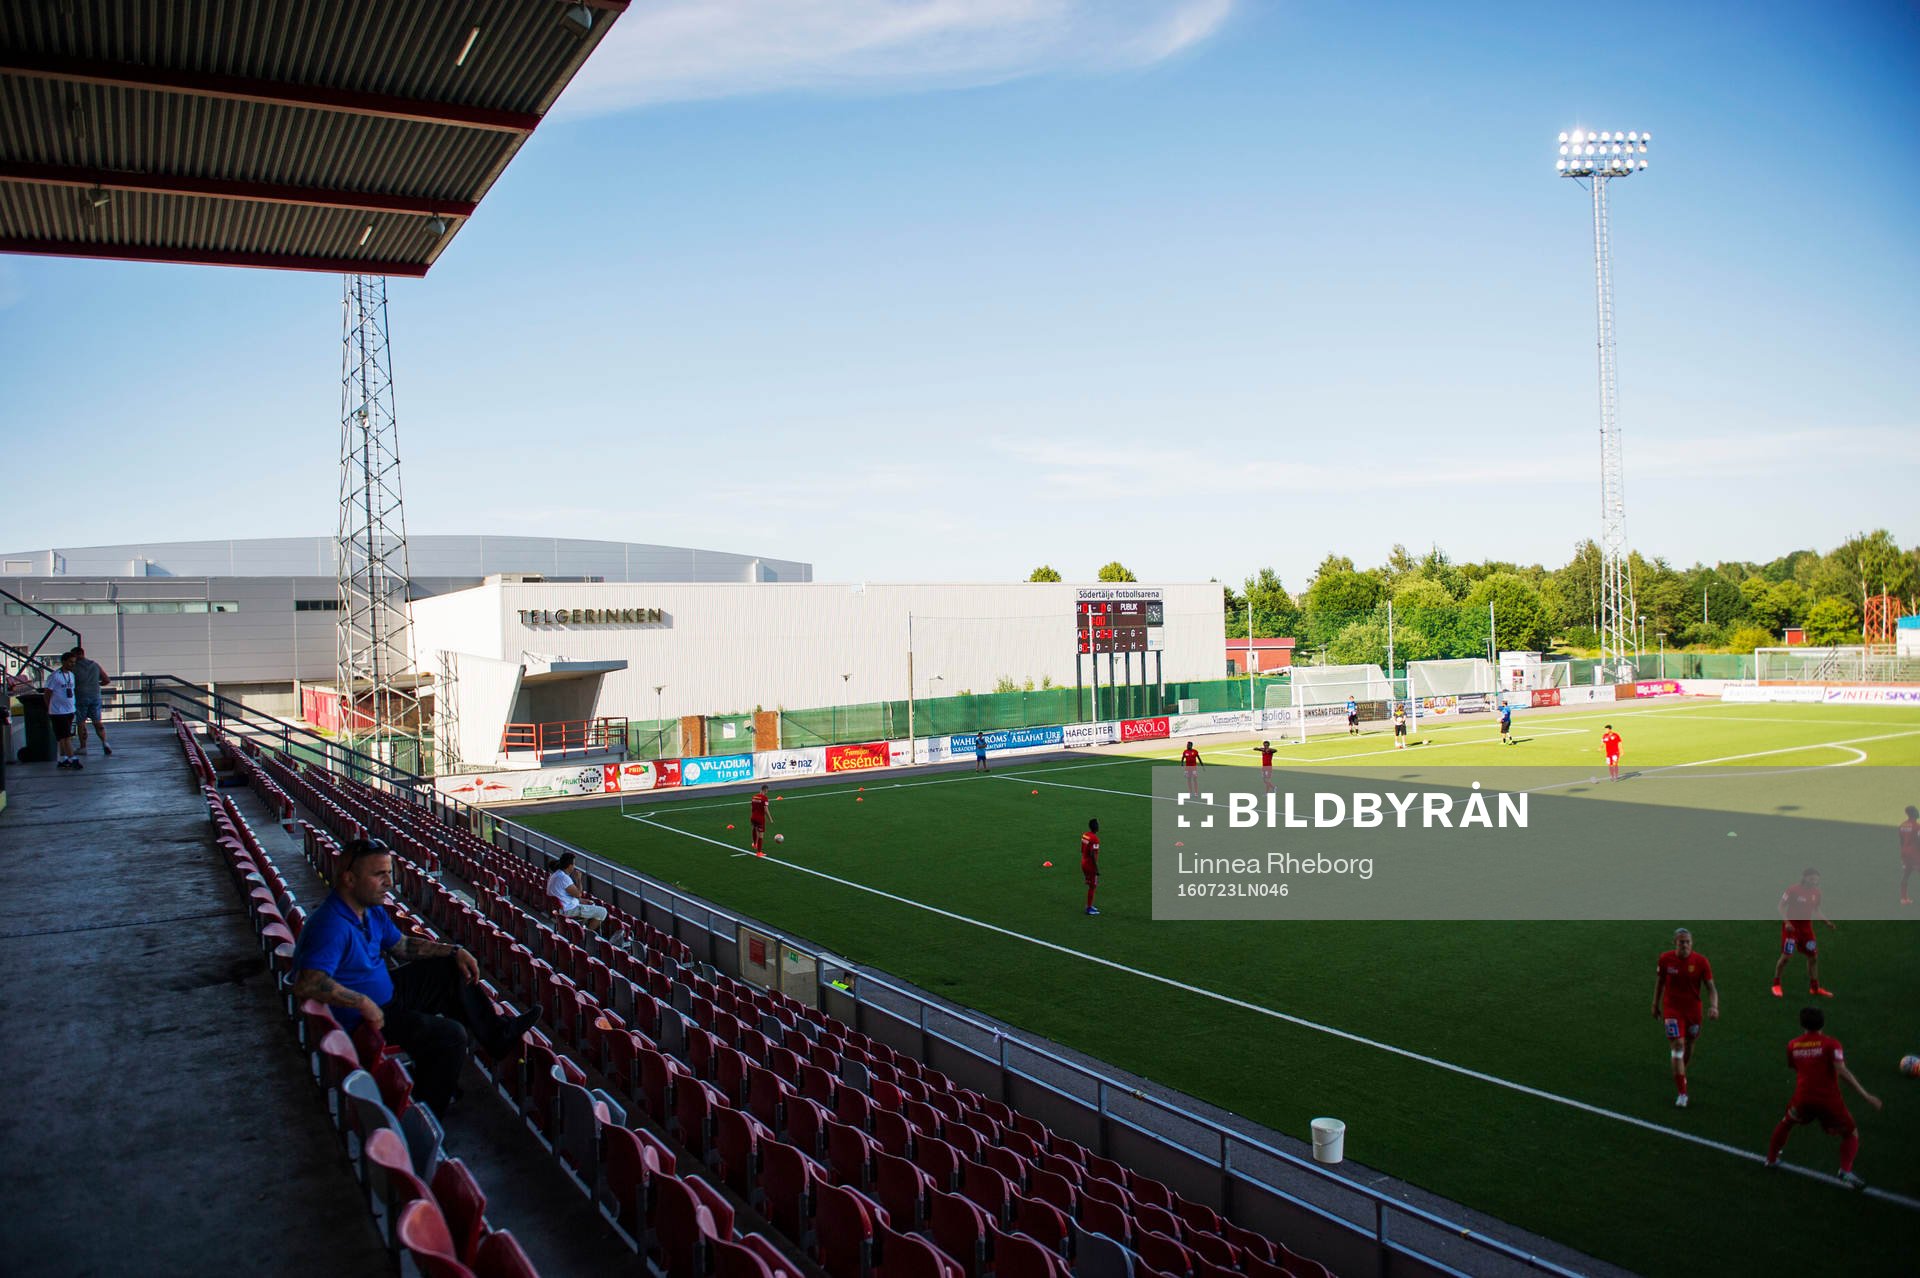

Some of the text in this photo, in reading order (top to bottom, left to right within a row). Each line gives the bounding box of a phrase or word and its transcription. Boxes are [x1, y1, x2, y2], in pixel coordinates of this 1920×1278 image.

[1079, 590, 1160, 600] Södertälje fotbollsarena
[517, 608, 662, 624] TELGERINKEN
[1124, 721, 1166, 735] BAROLO
[700, 759, 750, 771] VALADIUM
